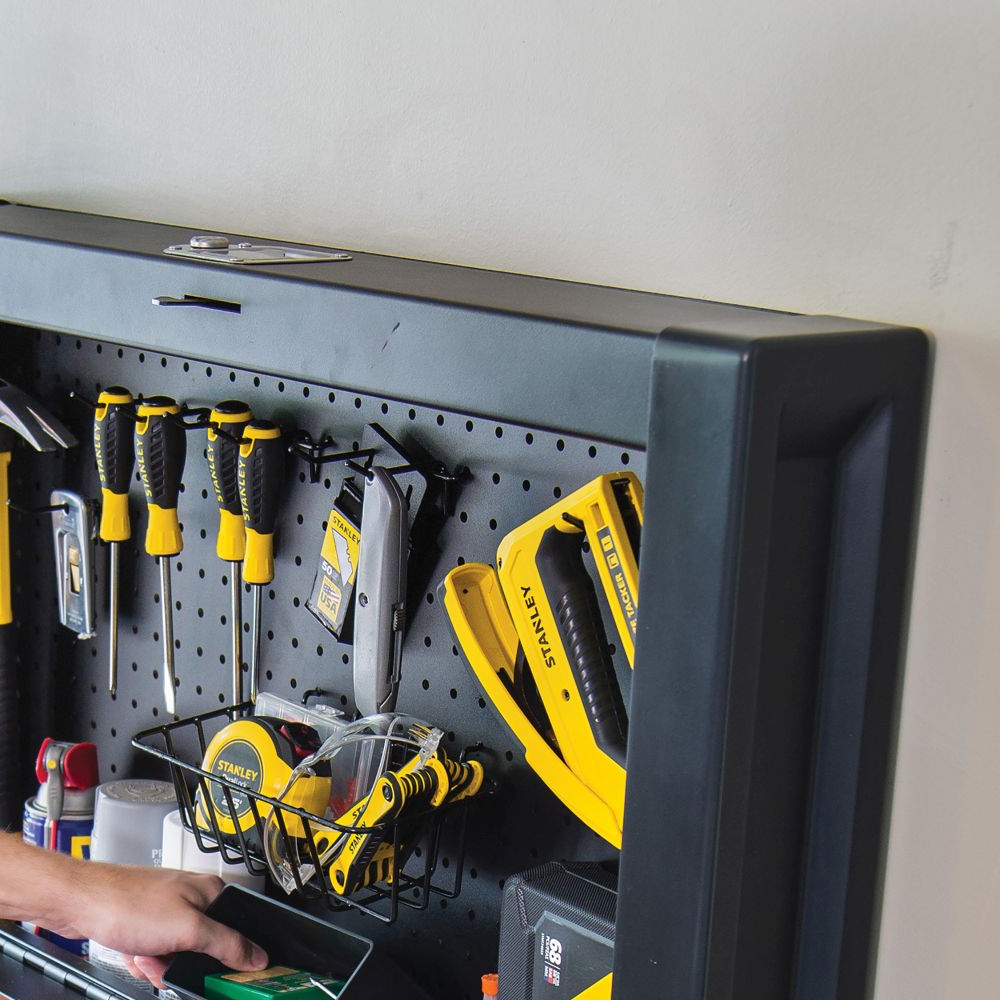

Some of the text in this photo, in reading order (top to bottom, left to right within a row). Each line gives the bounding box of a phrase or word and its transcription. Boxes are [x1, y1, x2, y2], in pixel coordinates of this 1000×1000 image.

[94, 425, 106, 482] STANLEY
[136, 440, 153, 498] STANLEY
[207, 446, 224, 503] STANLEY
[238, 460, 251, 521] STANLEY
[333, 516, 361, 545] STANLEY
[321, 560, 333, 576] 50
[320, 594, 338, 615] USA
[614, 572, 638, 619] TACKER
[520, 585, 556, 669] STANLEY
[217, 760, 258, 782] STANLEY
[549, 938, 562, 965] 68
